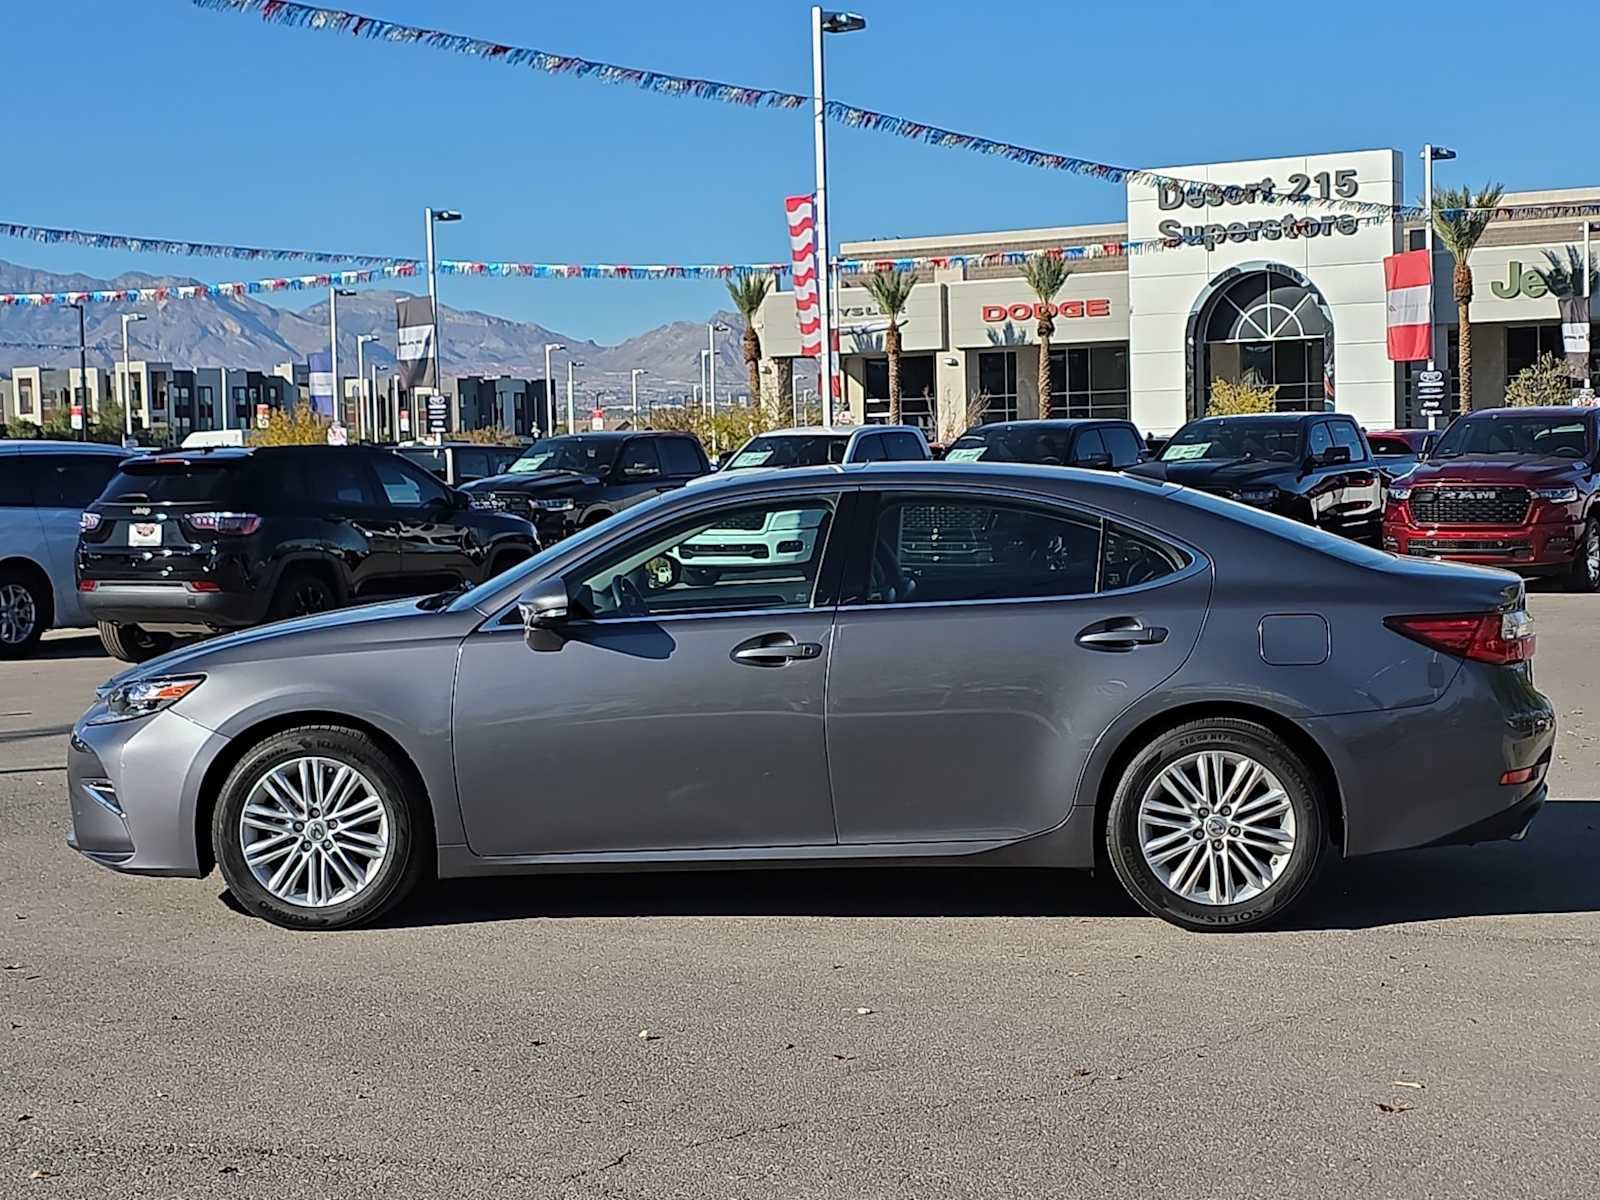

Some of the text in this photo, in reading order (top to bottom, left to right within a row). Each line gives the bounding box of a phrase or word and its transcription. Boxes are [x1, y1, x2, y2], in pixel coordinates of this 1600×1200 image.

[1158, 169, 1359, 211] Desert 215
[1158, 213, 1359, 251] Superstore
[1490, 260, 1548, 299] Je
[982, 299, 1111, 322] DODGE
